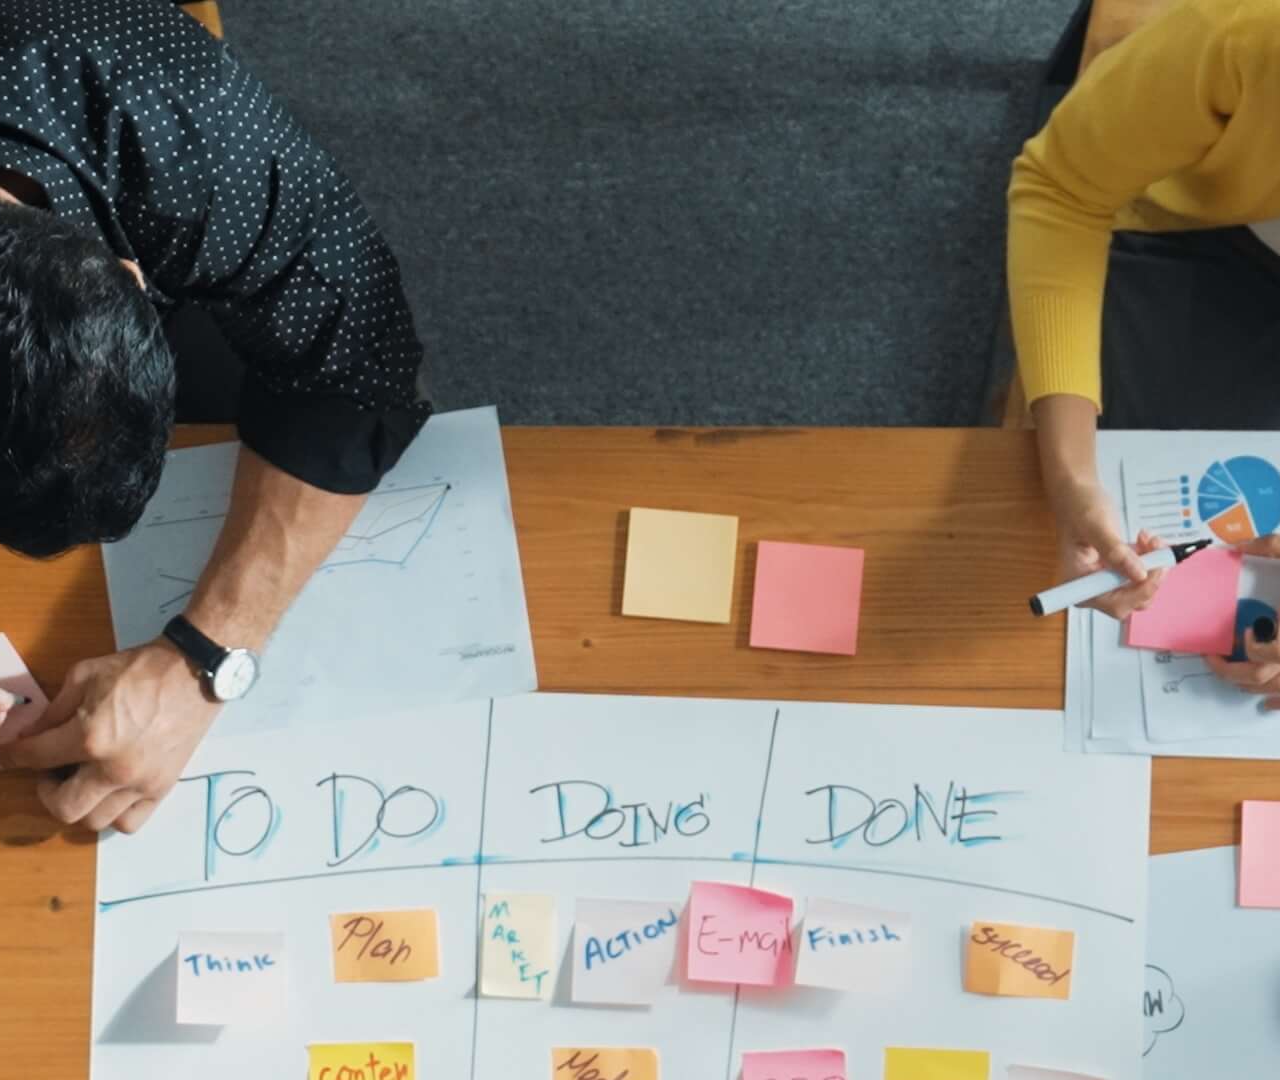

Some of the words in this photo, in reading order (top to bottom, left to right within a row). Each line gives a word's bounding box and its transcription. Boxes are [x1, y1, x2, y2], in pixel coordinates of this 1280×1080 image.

[179, 771, 277, 882] TO
[317, 773, 443, 867] DO
[805, 781, 1005, 848] DONE
[337, 916, 412, 963] Plan
[584, 908, 678, 970] ACTION
[807, 923, 901, 952] Finish
